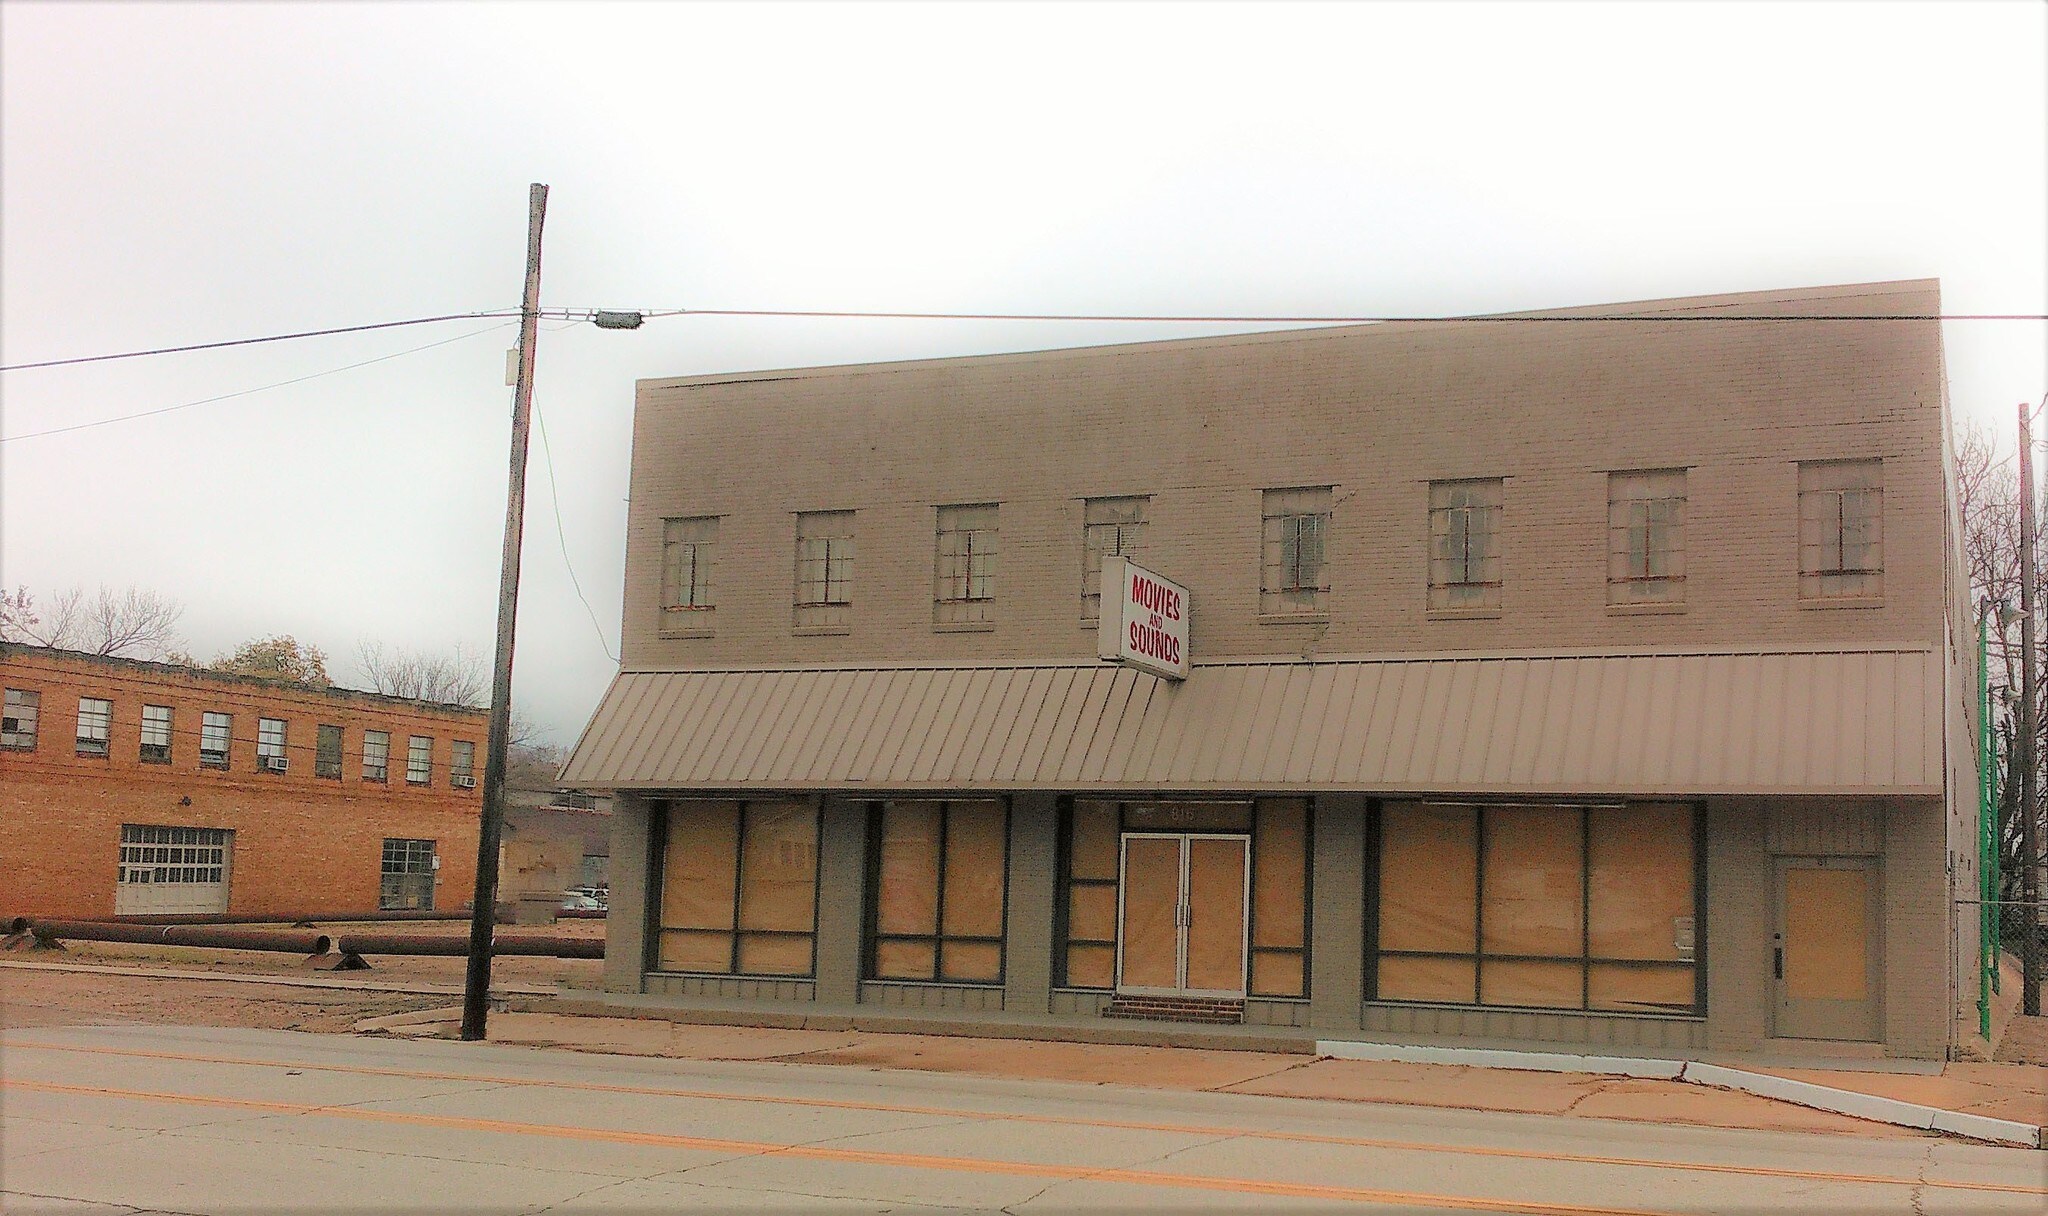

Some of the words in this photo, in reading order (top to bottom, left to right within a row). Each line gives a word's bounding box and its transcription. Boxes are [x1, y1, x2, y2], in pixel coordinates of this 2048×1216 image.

[1132, 574, 1180, 621] MOVIES
[1130, 621, 1180, 665] SOUNDS
[1149, 613, 1163, 629] AND
